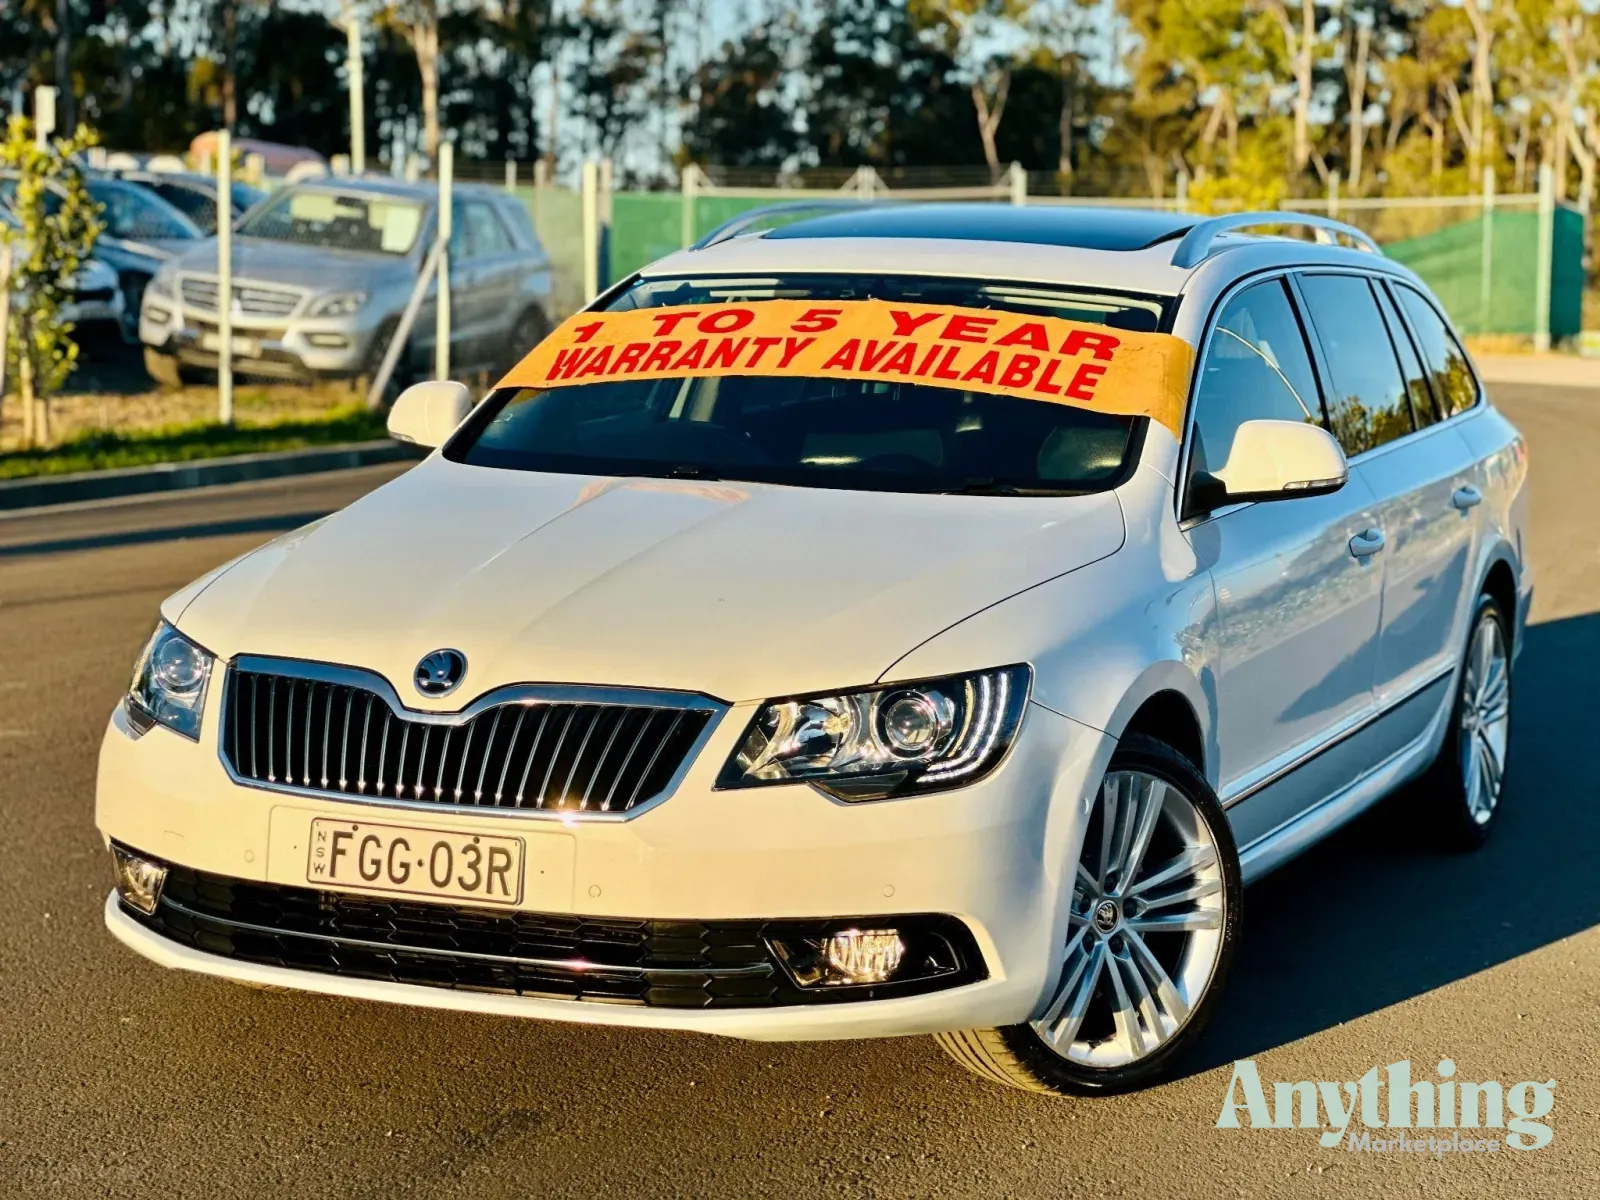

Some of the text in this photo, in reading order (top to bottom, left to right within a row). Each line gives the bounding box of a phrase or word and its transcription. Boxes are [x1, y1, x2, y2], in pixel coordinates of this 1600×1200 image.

[573, 308, 1121, 362] 1 TO 5 YEAR
[545, 337, 1107, 401] WARRANTY AVAILABLE
